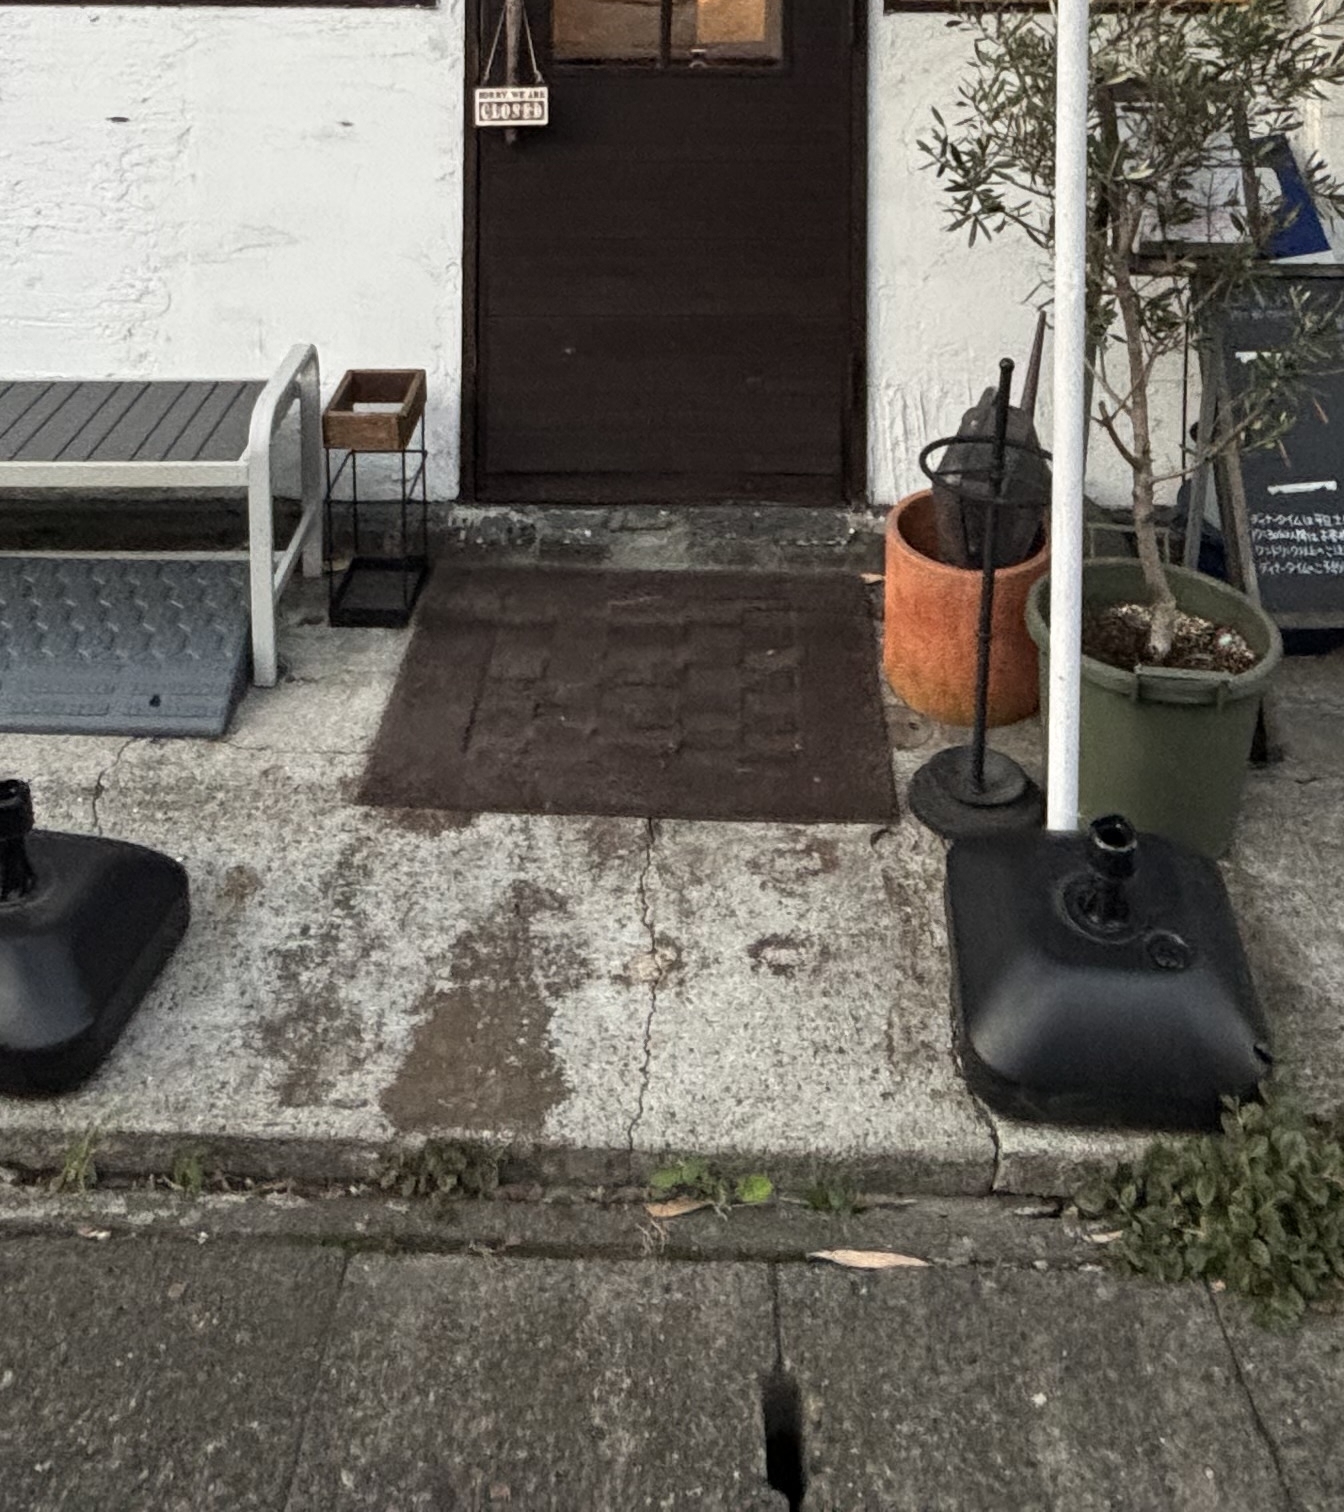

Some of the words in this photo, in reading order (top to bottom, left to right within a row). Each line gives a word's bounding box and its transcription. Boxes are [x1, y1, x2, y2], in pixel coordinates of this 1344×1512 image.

[511, 91, 525, 99] WE
[528, 90, 546, 99] ARE
[480, 102, 543, 120] CLOSED
